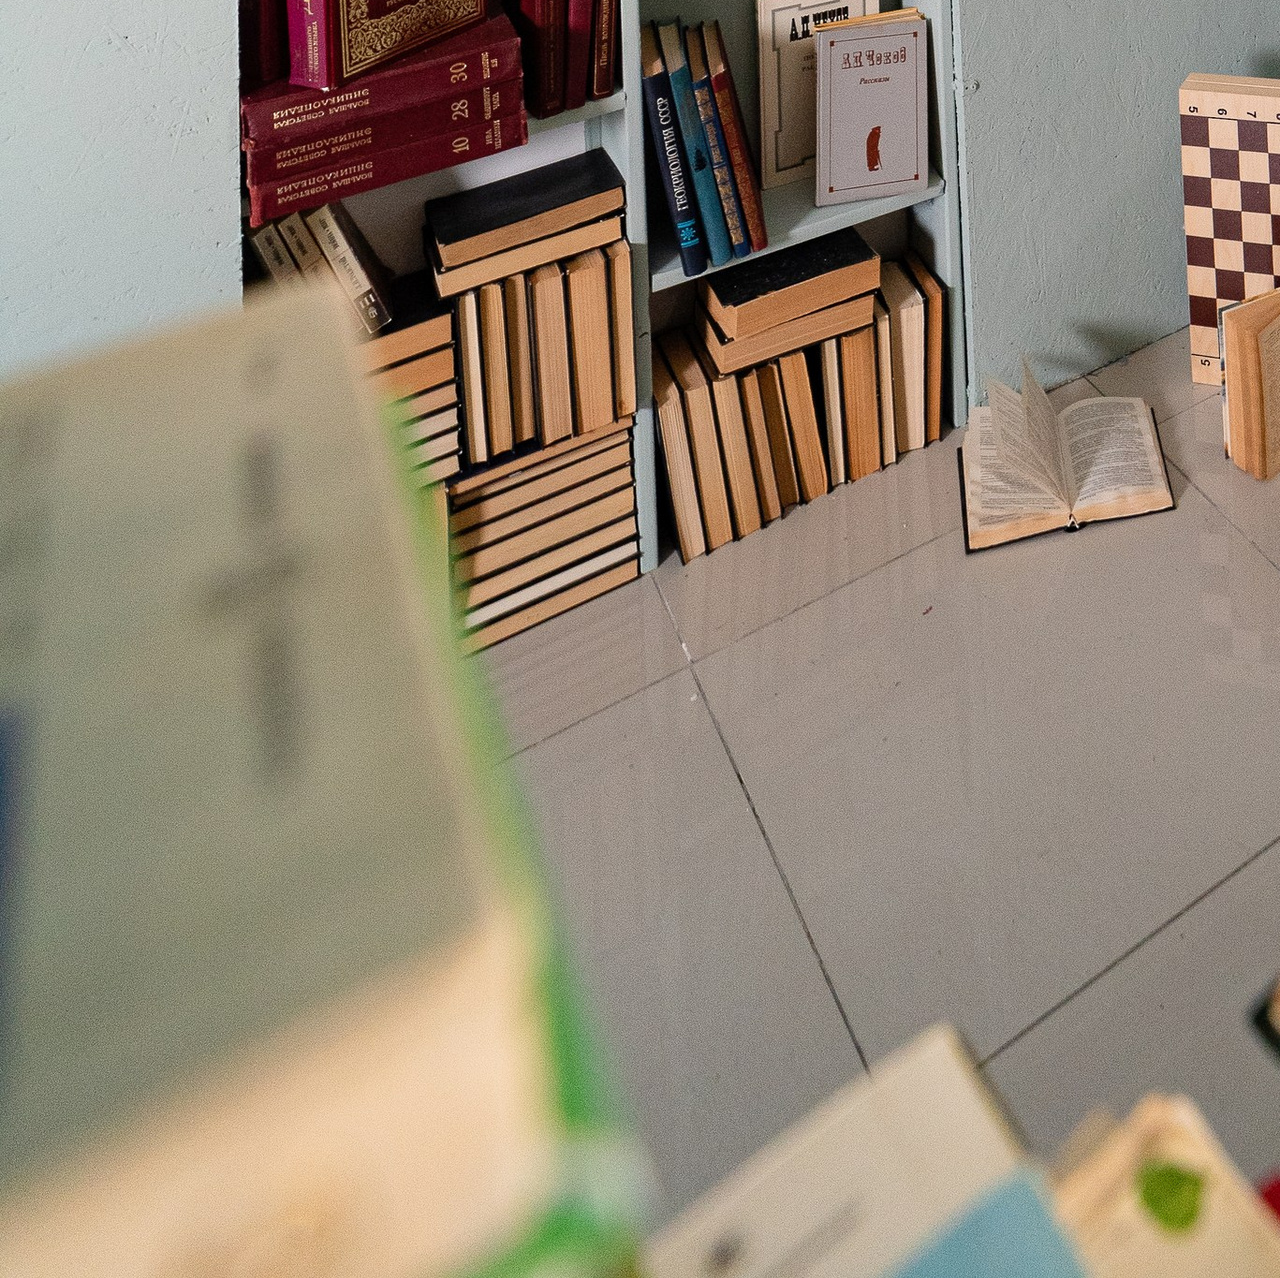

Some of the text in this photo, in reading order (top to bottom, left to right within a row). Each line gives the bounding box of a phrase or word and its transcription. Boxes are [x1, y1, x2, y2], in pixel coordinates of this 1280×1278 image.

[450, 61, 468, 84] 30
[858, 75, 891, 86] Рассказы
[273, 88, 370, 120] ЭНЦИКЛОПЕДИЯ
[273, 98, 370, 130] БОЛЬШАЯ СОВЕТСКАЯ
[451, 99, 469, 121] 28
[1217, 108, 1228, 116] 6
[276, 127, 372, 160] ЭНЦИКЛОПЕДИЯ
[276, 137, 372, 170] БОЛЬШАЯ СОВЕТСКАЯ
[452, 136, 470, 154] 10
[656, 97, 690, 212] ГЕОКРИОЛОГИЯ СССР
[277, 161, 373, 195] ЭНЦИКЛОПЕДИЯ
[277, 171, 373, 205] БОЛЬШАЯ СОВЕТСКАЯ
[1201, 358, 1211, 366] 5
